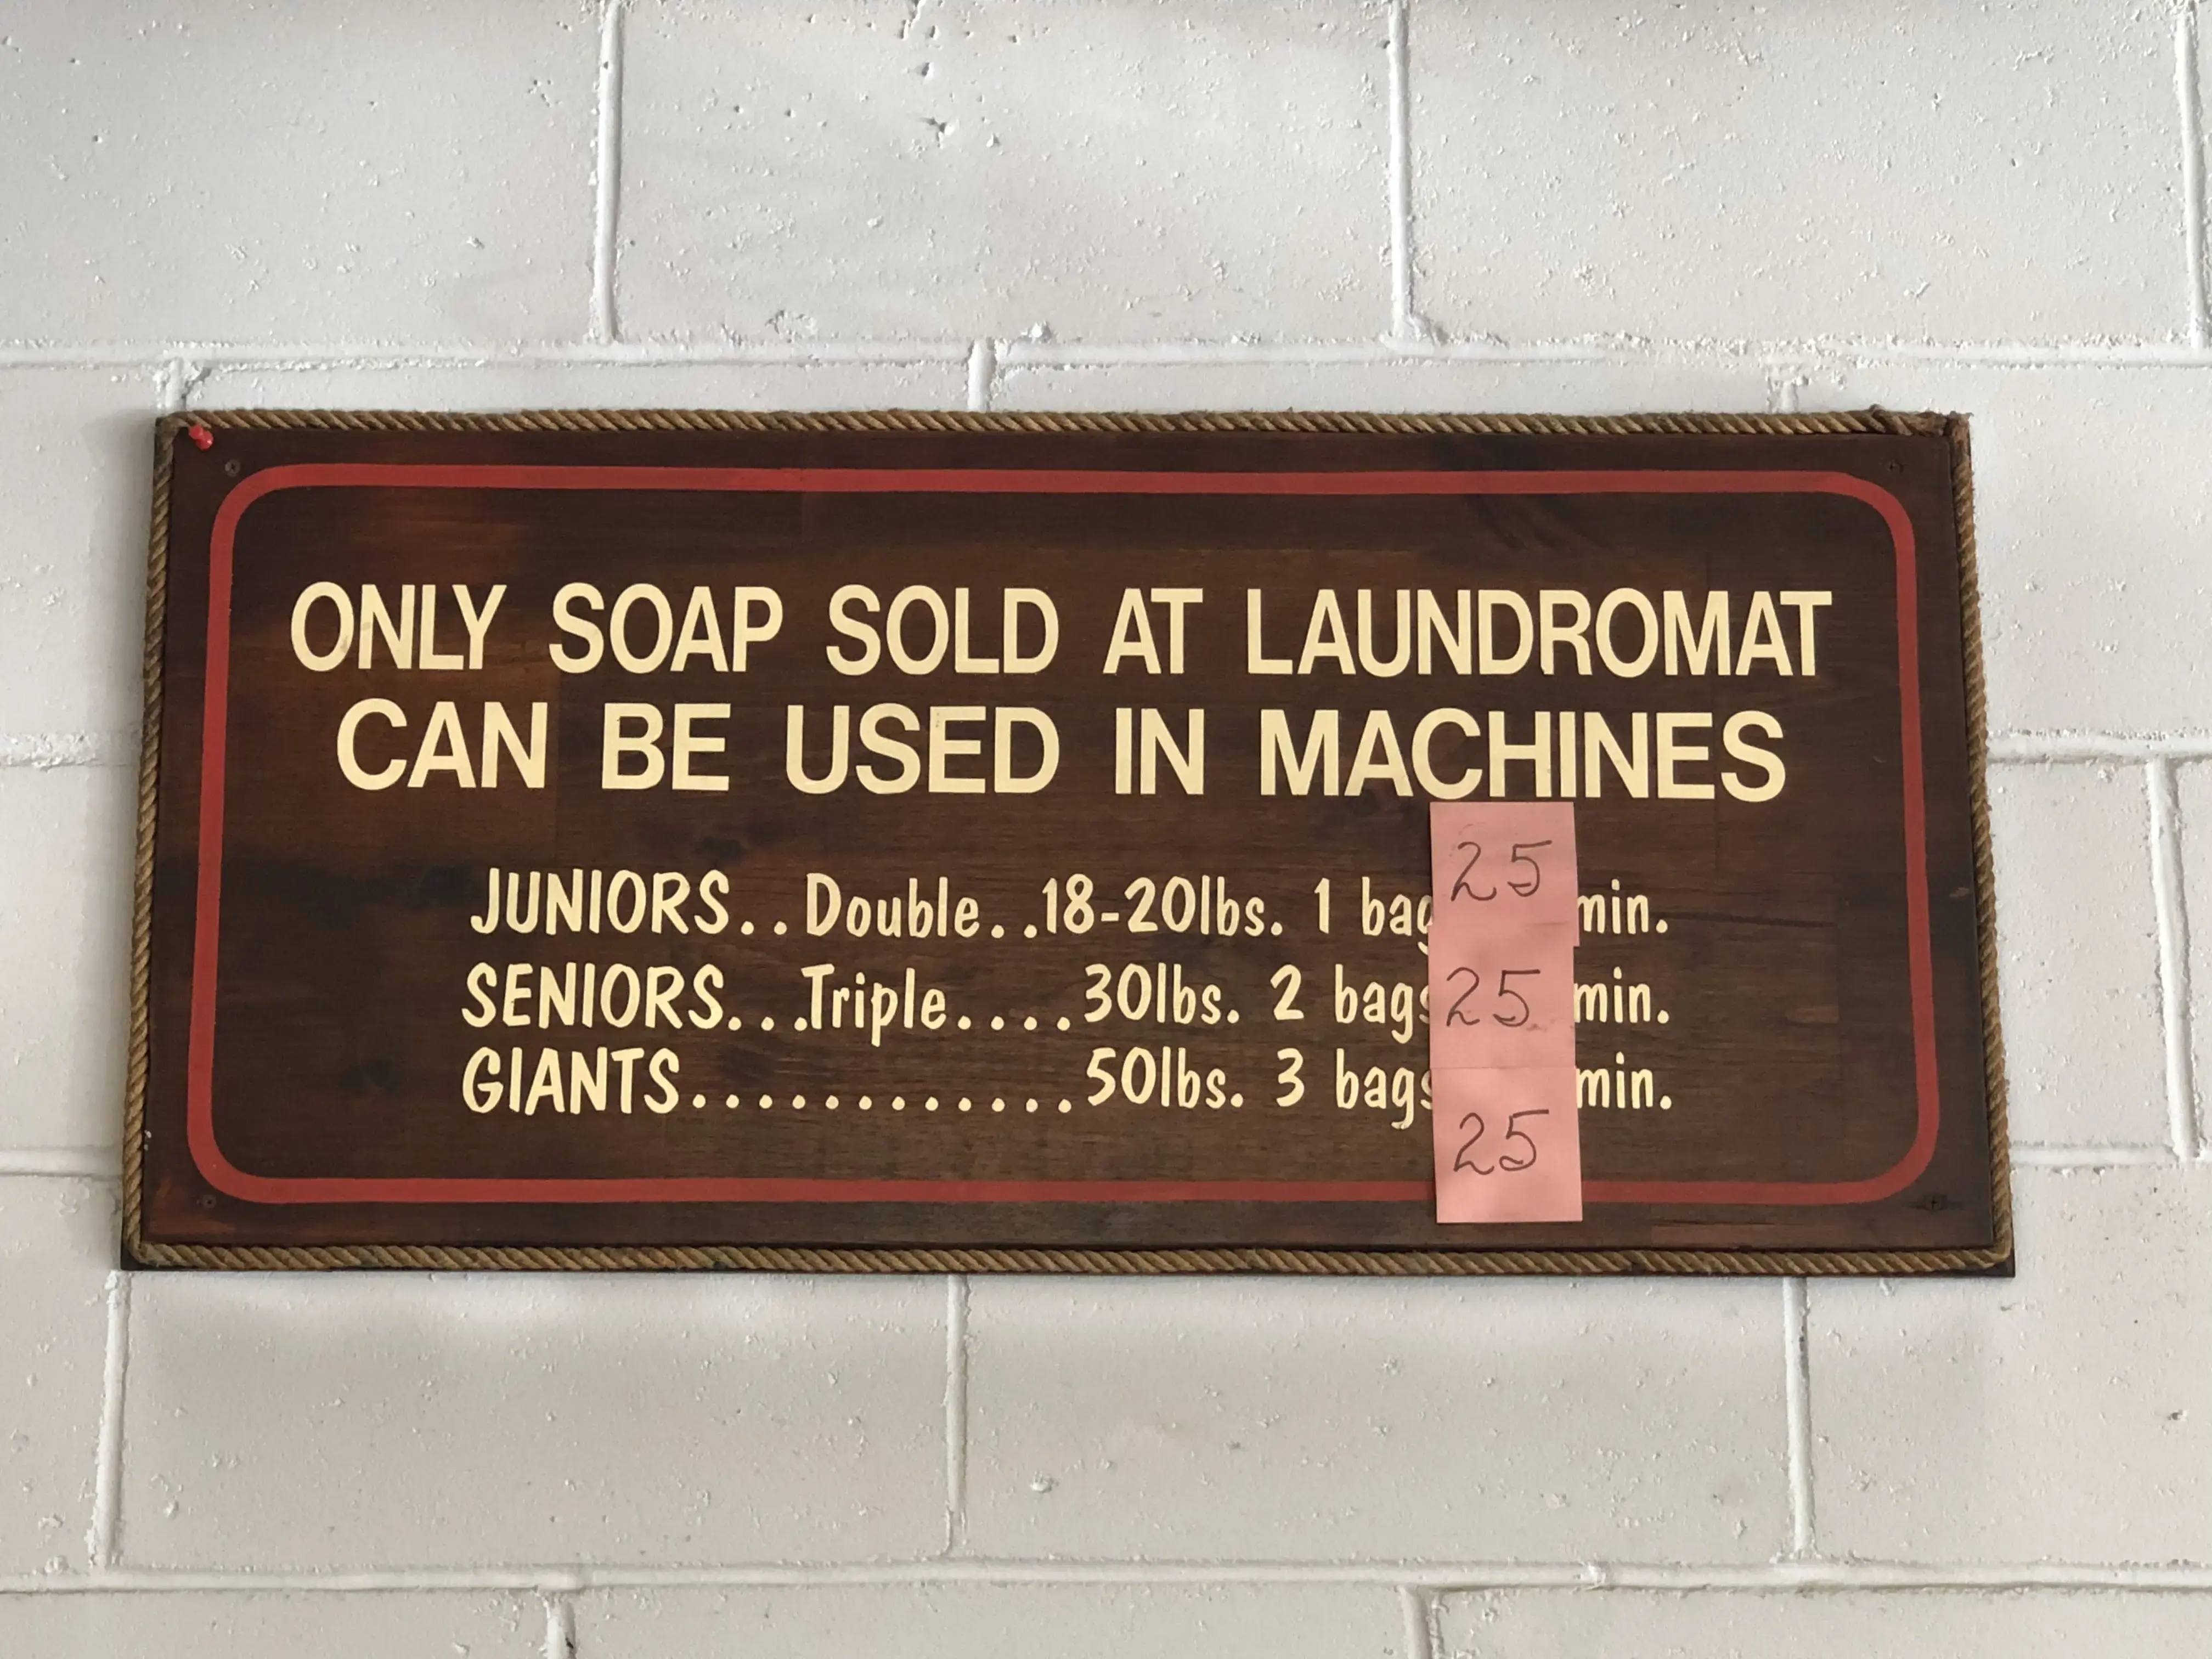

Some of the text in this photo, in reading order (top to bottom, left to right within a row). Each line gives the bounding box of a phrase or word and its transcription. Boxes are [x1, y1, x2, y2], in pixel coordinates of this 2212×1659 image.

[290, 581, 1833, 679] ONLY SOAP SOLD AT LAUNDROMAT
[336, 697, 1786, 803] CAN BE USED IN MACHINES
[1451, 839, 1553, 902] 25
[1313, 877, 1330, 935] 1
[1577, 878, 1668, 935] min.
[1269, 963, 1305, 1021] 2
[1573, 966, 1670, 1024] min.
[1445, 966, 1541, 1028] 25
[1276, 1047, 1305, 1108] 3
[1575, 1051, 1672, 1110] min.
[1453, 1109, 1550, 1176] 25
